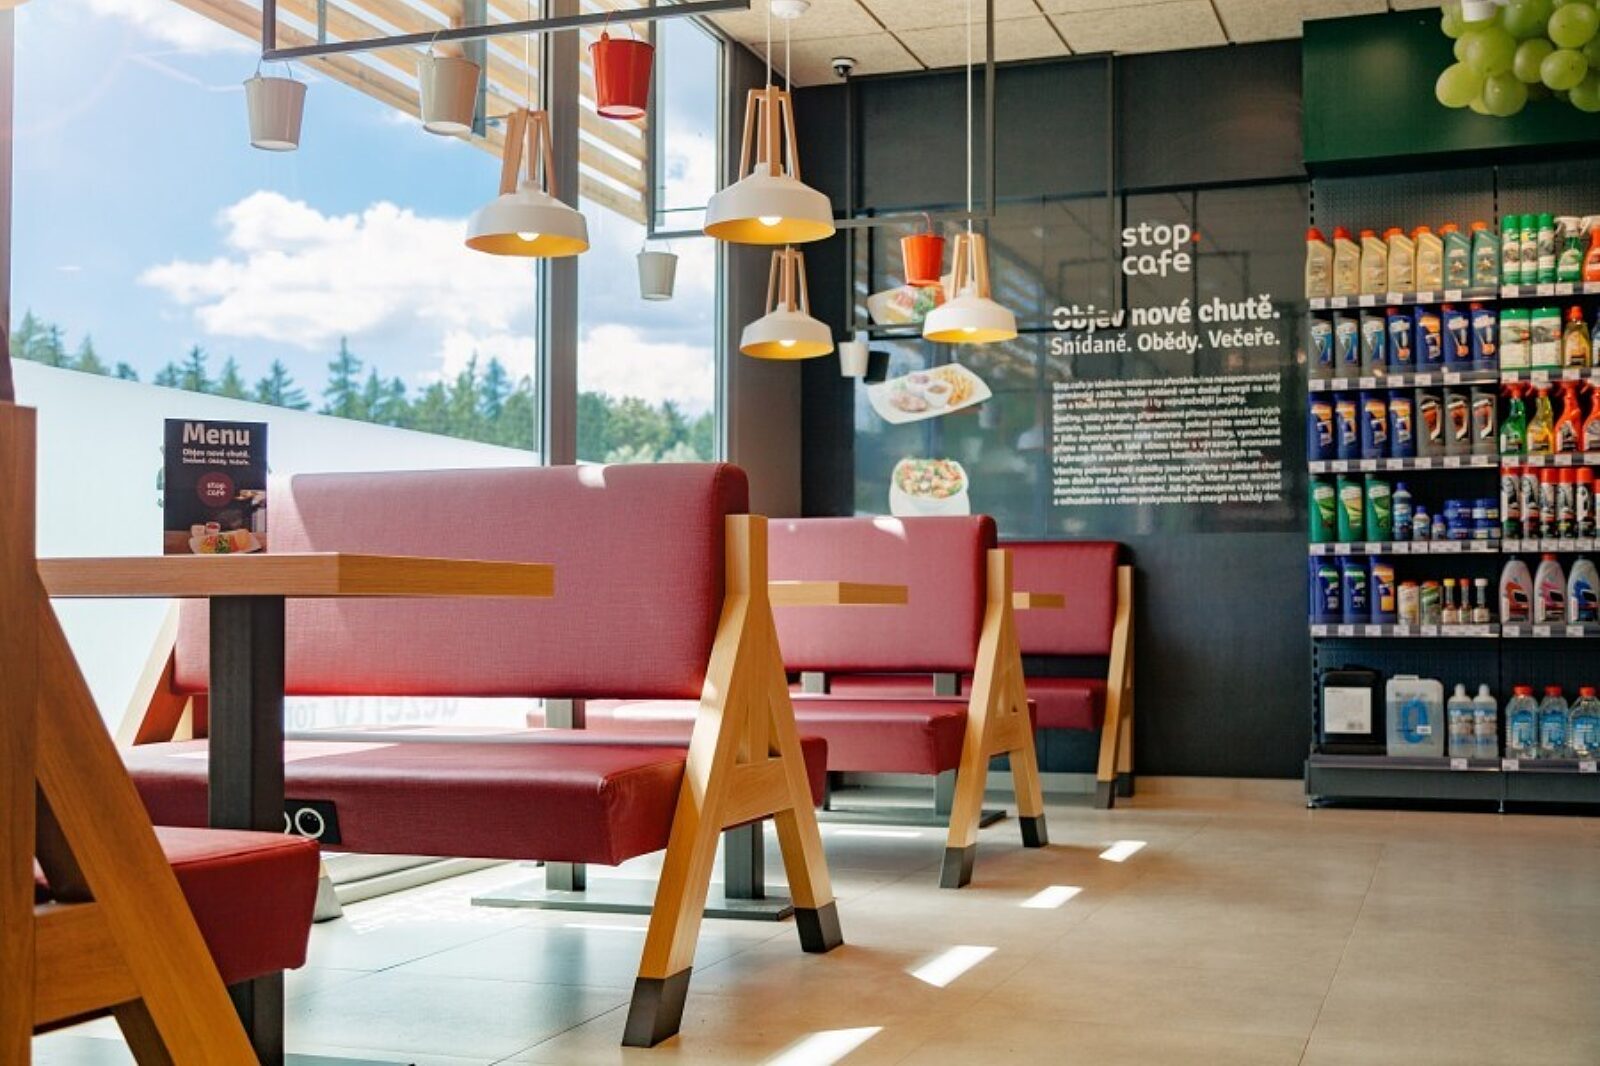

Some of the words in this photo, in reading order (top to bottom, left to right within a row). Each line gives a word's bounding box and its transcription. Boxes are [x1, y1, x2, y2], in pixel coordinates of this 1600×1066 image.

[1122, 249, 1191, 277] cafe
[1132, 299, 1191, 326] nové
[1198, 294, 1281, 323] chutě.
[1050, 334, 1132, 356] Snídaně.
[1137, 331, 1203, 354] Obědy.
[1208, 327, 1281, 349] Večeře.
[183, 422, 250, 445] Menu
